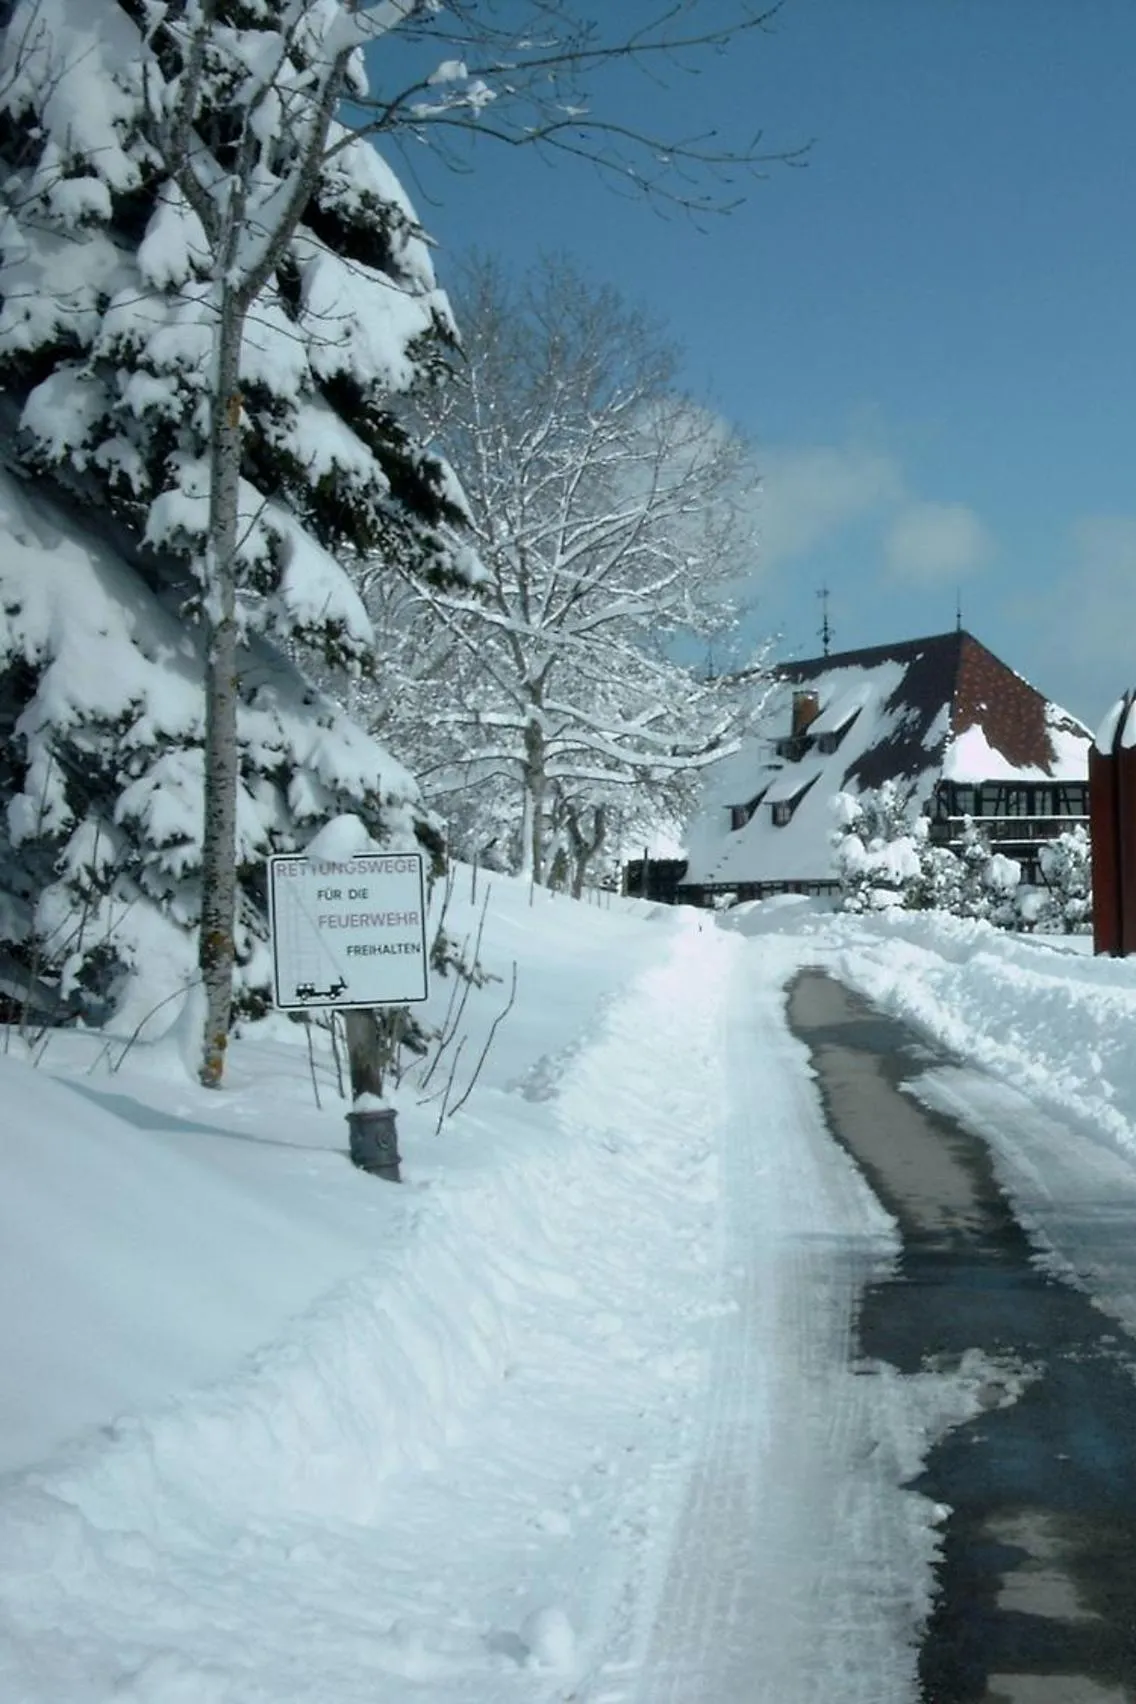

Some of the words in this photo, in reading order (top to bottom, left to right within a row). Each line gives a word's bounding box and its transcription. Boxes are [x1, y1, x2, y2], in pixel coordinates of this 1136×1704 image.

[317, 888, 341, 900] FÜR
[348, 888, 369, 900] DIE
[318, 912, 419, 928] FEUERWEHR
[346, 943, 421, 955] FREIHALTEN
